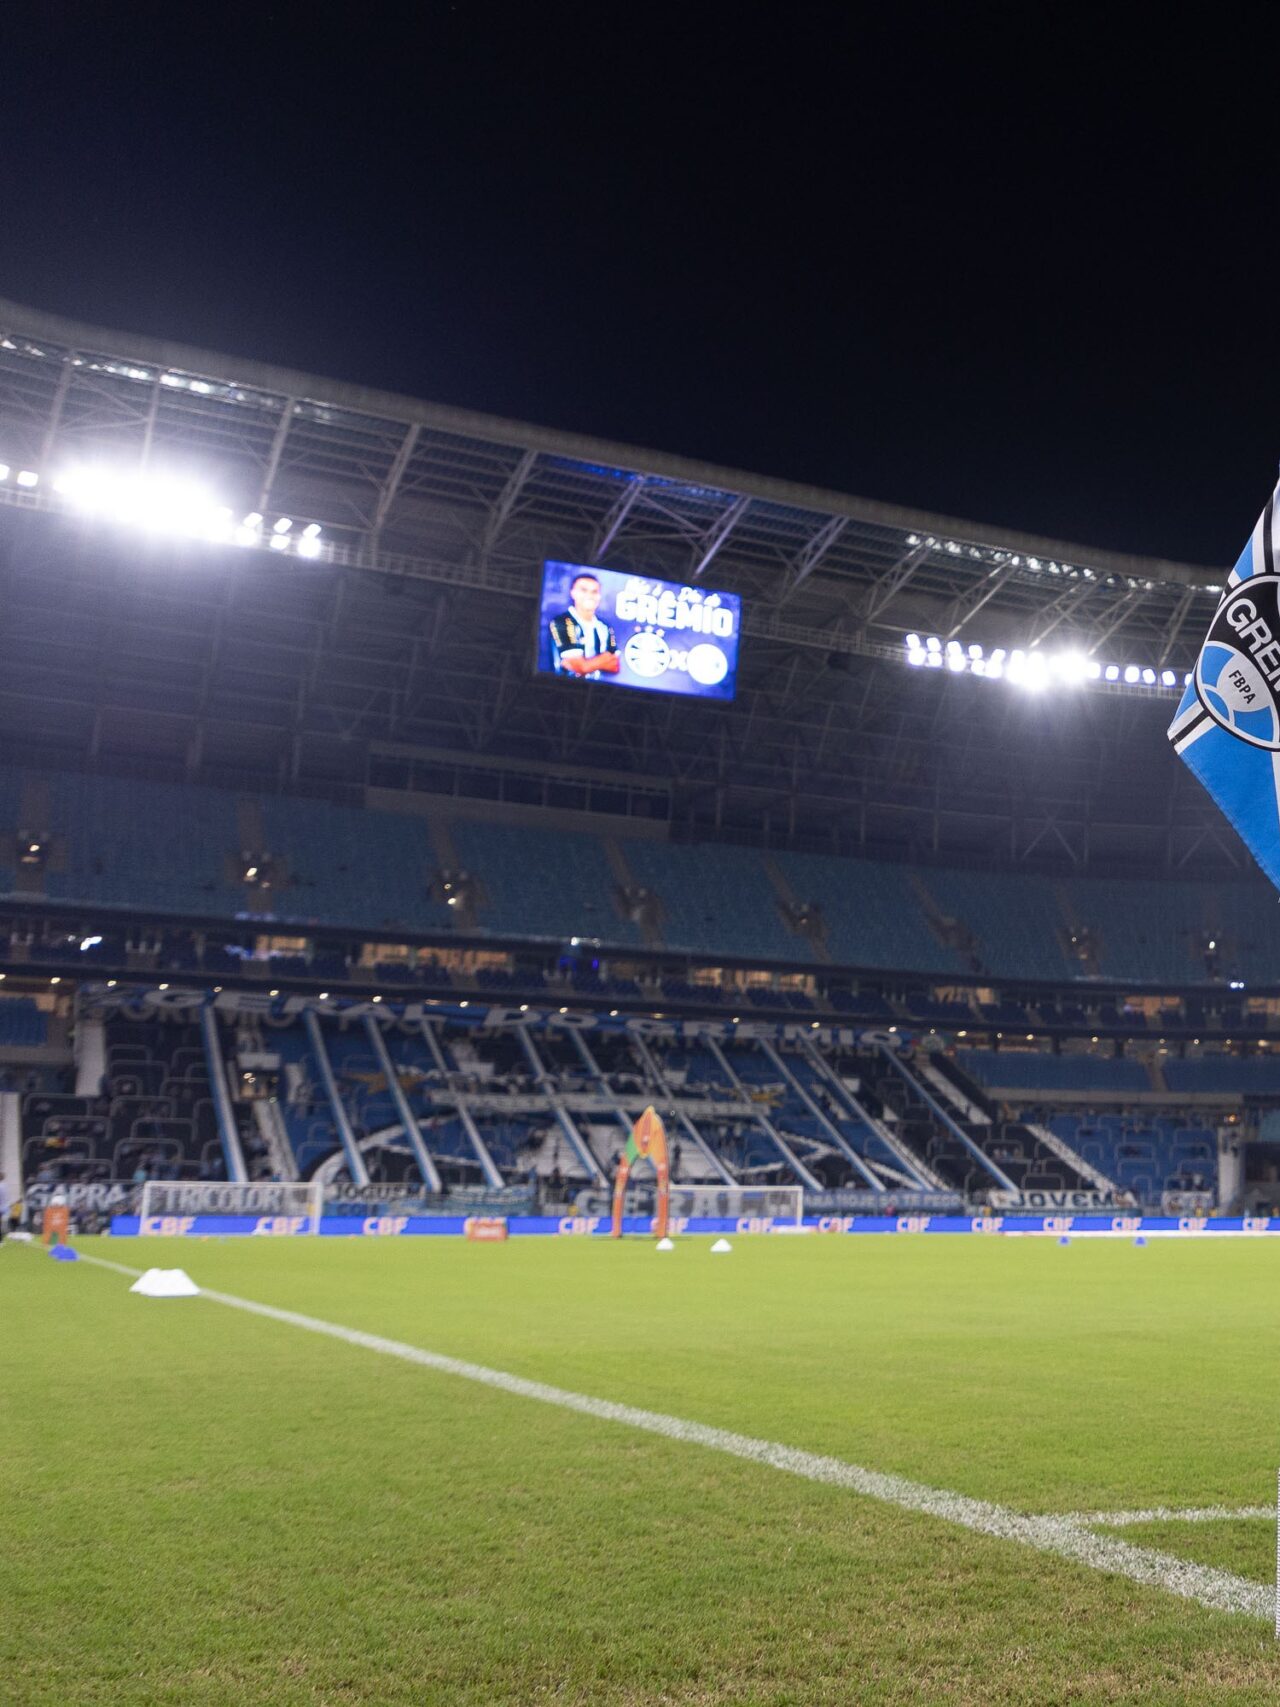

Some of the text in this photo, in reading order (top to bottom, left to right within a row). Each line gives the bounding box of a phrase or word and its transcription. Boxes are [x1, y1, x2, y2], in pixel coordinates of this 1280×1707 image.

[1228, 669, 1256, 704] FBPA
[145, 1217, 196, 1234] CBF
[256, 1217, 307, 1234] CBF
[363, 1217, 408, 1234] CBF
[559, 1217, 600, 1233] CBF
[736, 1217, 774, 1233] CBF
